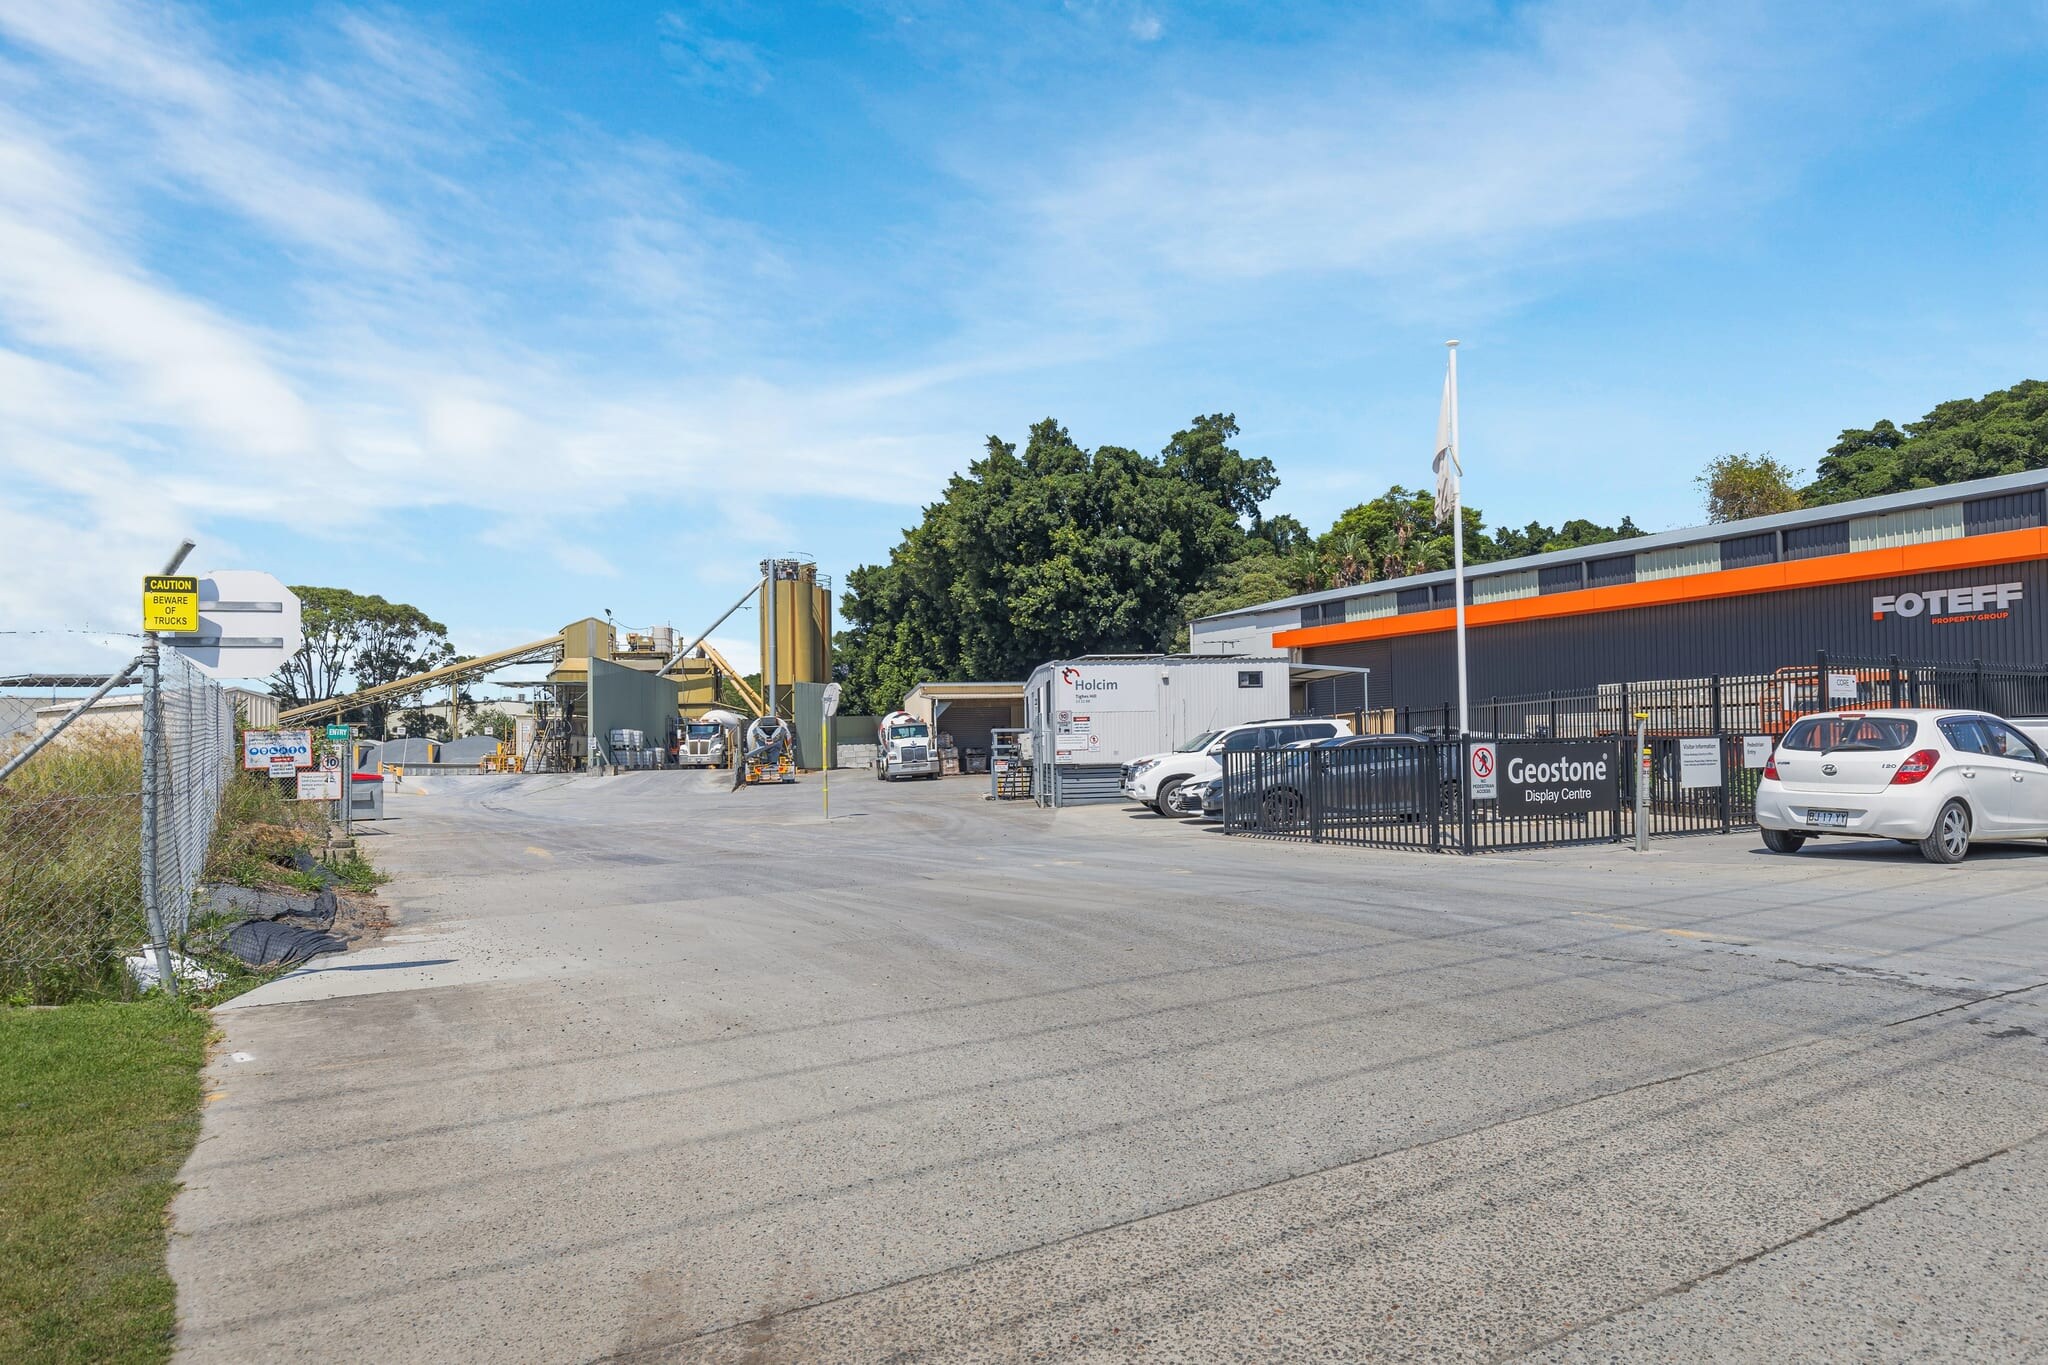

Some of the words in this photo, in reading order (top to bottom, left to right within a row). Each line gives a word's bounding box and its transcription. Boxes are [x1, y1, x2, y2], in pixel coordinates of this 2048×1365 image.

[150, 580, 192, 590] CAUTION
[153, 596, 188, 604] BEWARE
[1872, 581, 2023, 620] FOTEFF
[165, 606, 176, 614] OF
[154, 616, 187, 625] TRUCKS
[1931, 614, 1976, 625] PROPERTY
[1977, 612, 2009, 621] GROUP
[1075, 679, 1118, 690] Holcim
[329, 728, 347, 736] ENTRY
[326, 757, 337, 767] 10
[1507, 756, 1607, 784] Geostone
[1525, 789, 1559, 804] Display
[1561, 787, 1592, 800] Centre
